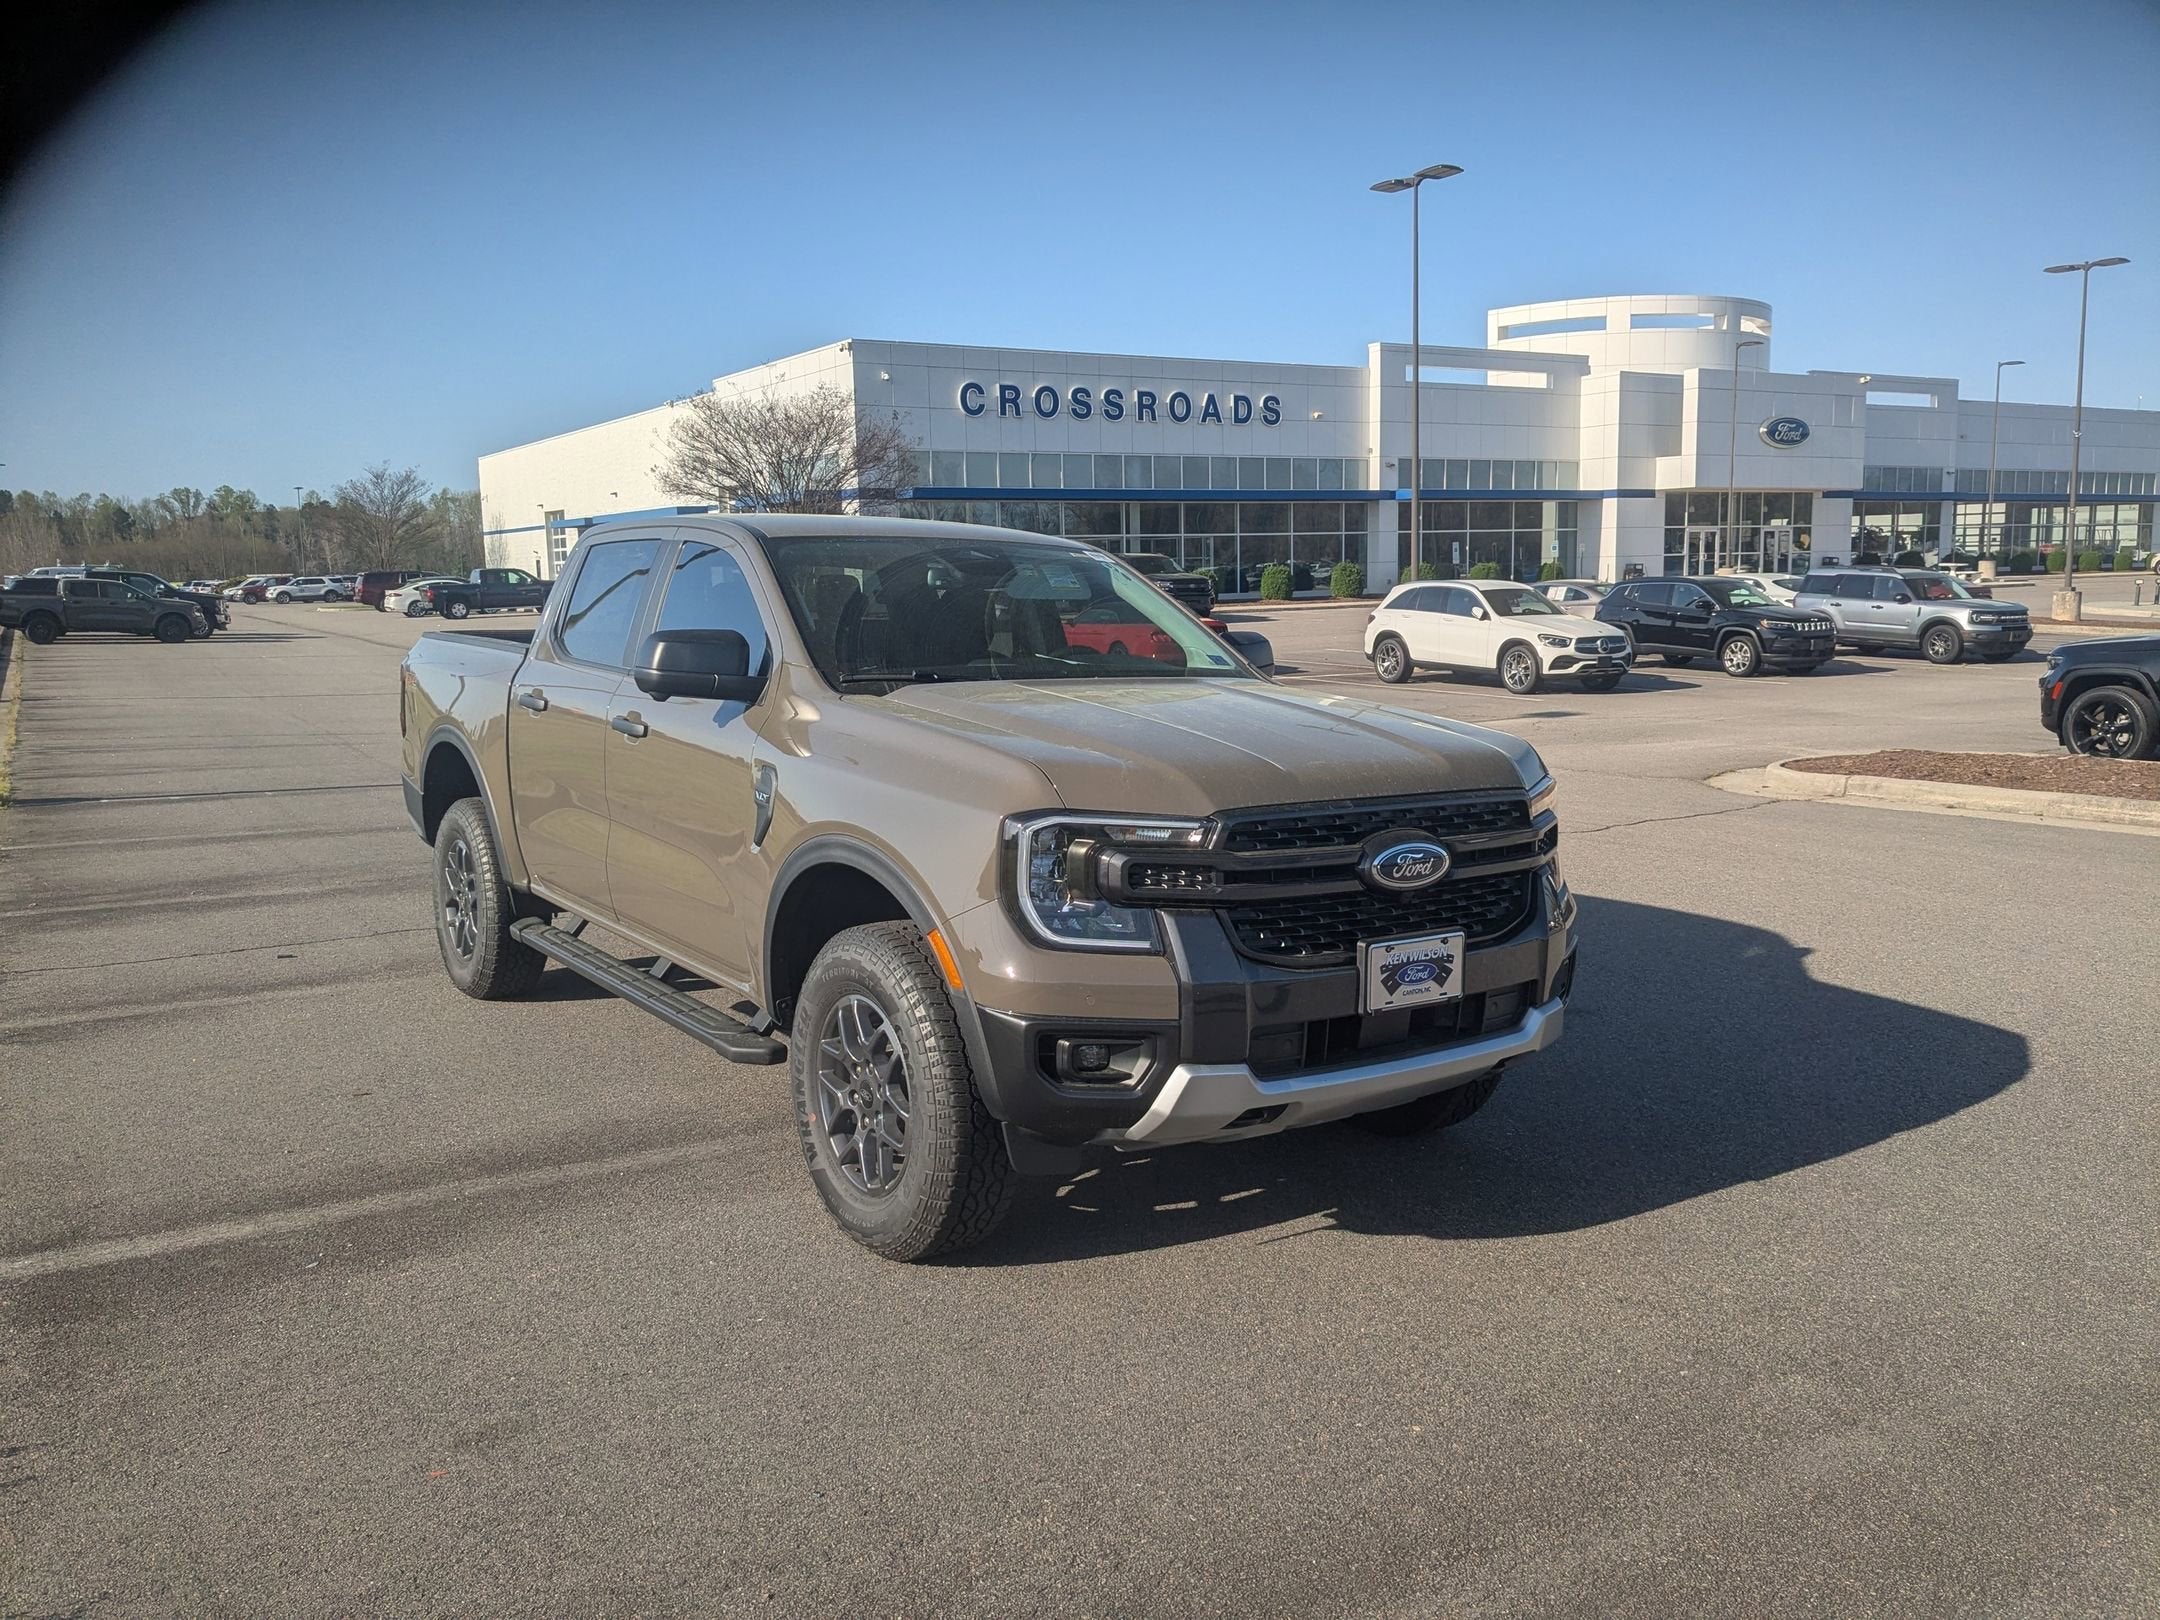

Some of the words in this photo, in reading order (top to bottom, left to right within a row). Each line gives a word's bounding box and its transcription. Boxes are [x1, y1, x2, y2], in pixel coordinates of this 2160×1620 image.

[958, 380, 1284, 427] CROSSROADS
[1774, 422, 1803, 441] Ford
[1392, 853, 1435, 878] Ford
[1386, 952, 1408, 966] KEN
[1407, 946, 1448, 962] WILSON
[821, 967, 860, 982] TERRITORY
[1404, 965, 1431, 982] Ford
[793, 1005, 818, 1165] WRANGLER
